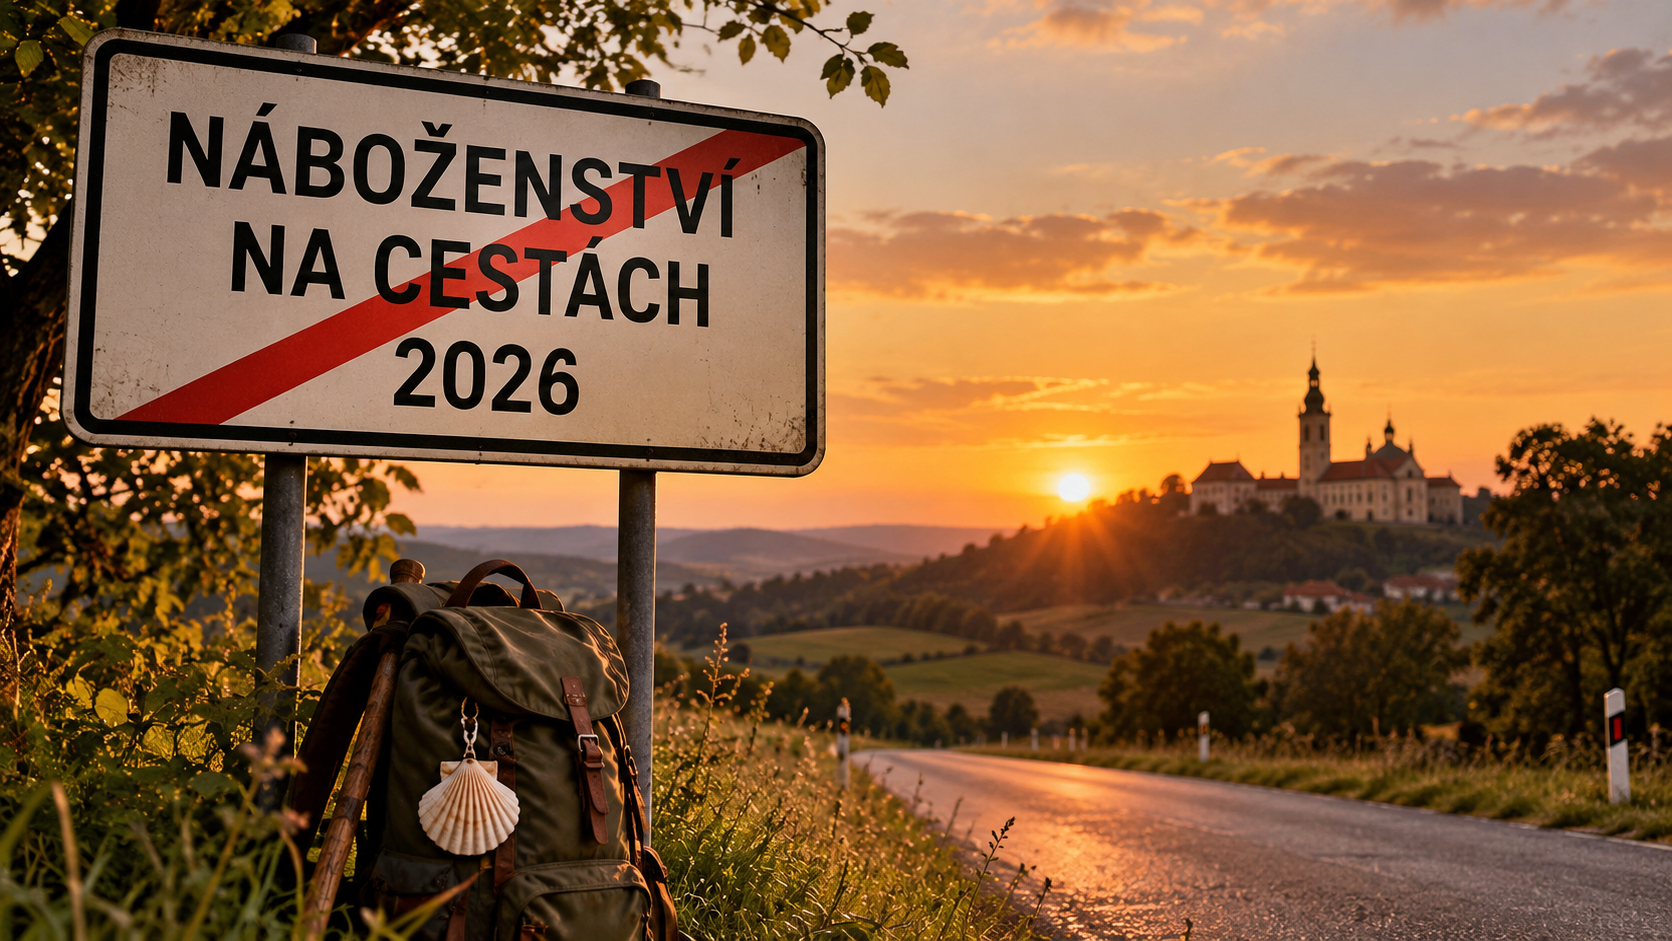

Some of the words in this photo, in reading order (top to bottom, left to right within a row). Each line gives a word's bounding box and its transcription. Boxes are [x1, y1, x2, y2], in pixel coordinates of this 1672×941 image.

[167, 103, 741, 238] NÁBOŽENSTVÍ
[231, 221, 346, 300] NA
[374, 236, 709, 328] CESTÁCH
[393, 337, 580, 416] 2026
